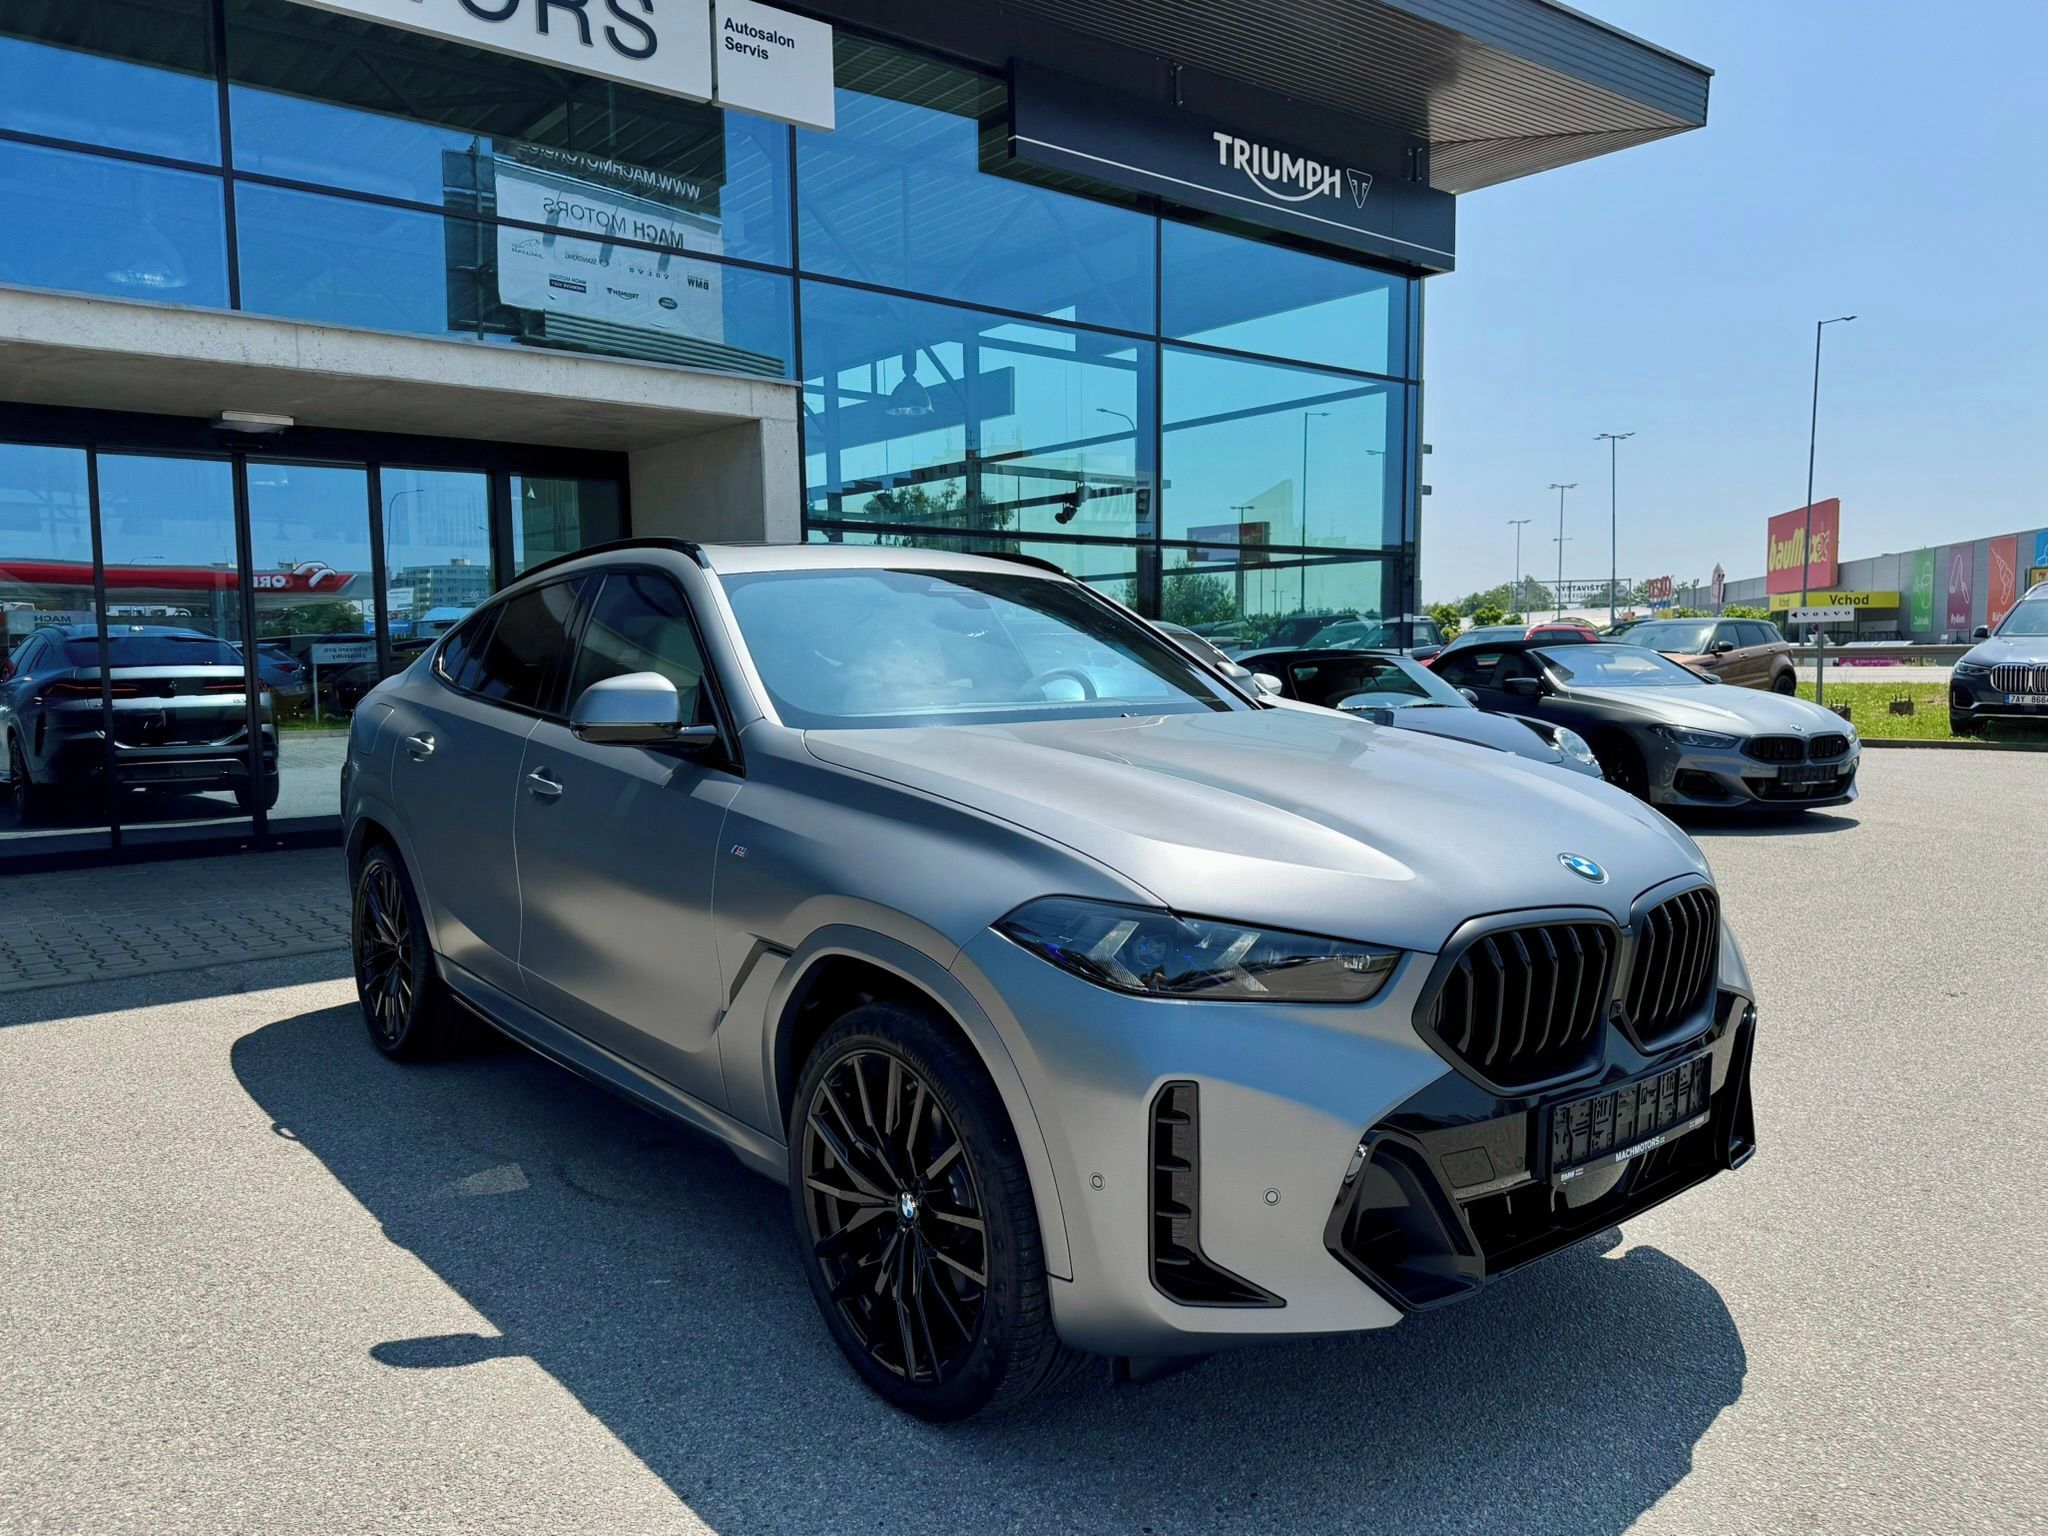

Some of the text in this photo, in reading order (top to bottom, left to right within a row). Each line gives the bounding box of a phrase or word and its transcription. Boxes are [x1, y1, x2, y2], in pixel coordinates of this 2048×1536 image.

[724, 17, 796, 49] Autosalon
[724, 36, 770, 61] Servis
[1213, 131, 1341, 202] TRIUMPH
[1829, 594, 1869, 606] Vchod
